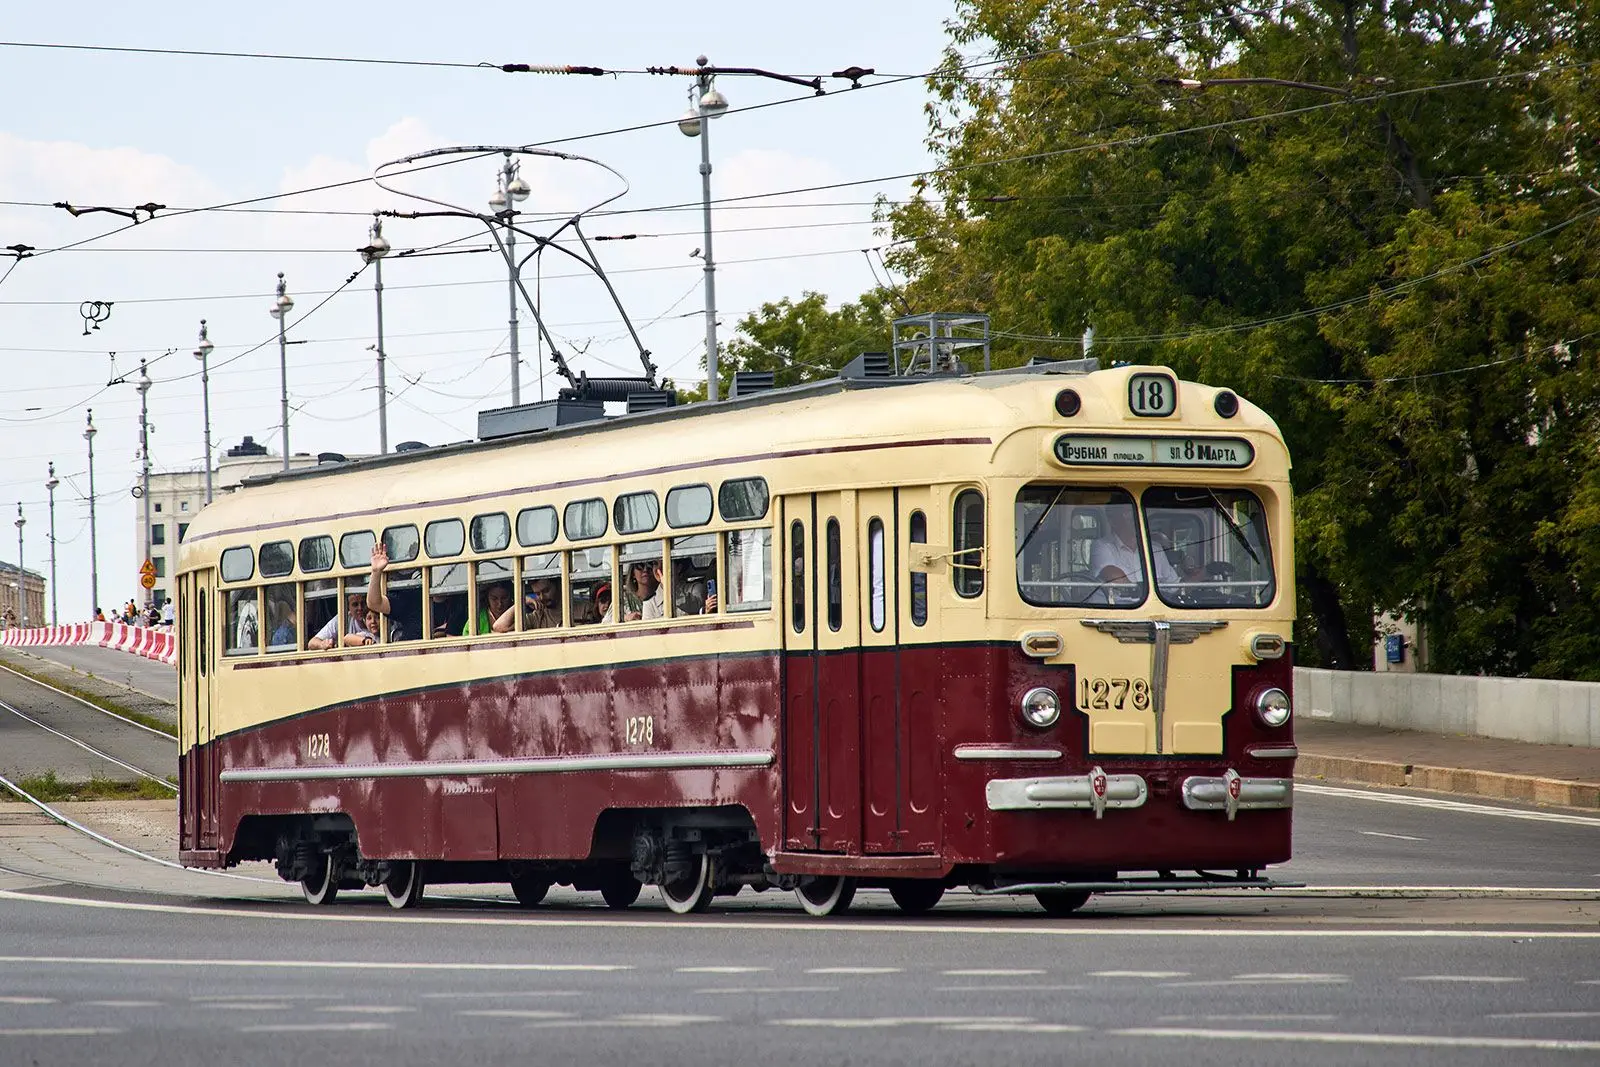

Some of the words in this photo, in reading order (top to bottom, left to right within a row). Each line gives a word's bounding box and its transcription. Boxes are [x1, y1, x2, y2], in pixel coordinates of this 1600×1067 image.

[1137, 381, 1164, 410] 18
[1184, 439, 1195, 460] 8
[1080, 677, 1150, 711] 1278
[626, 715, 653, 745] 1278
[308, 733, 330, 759] 1278
